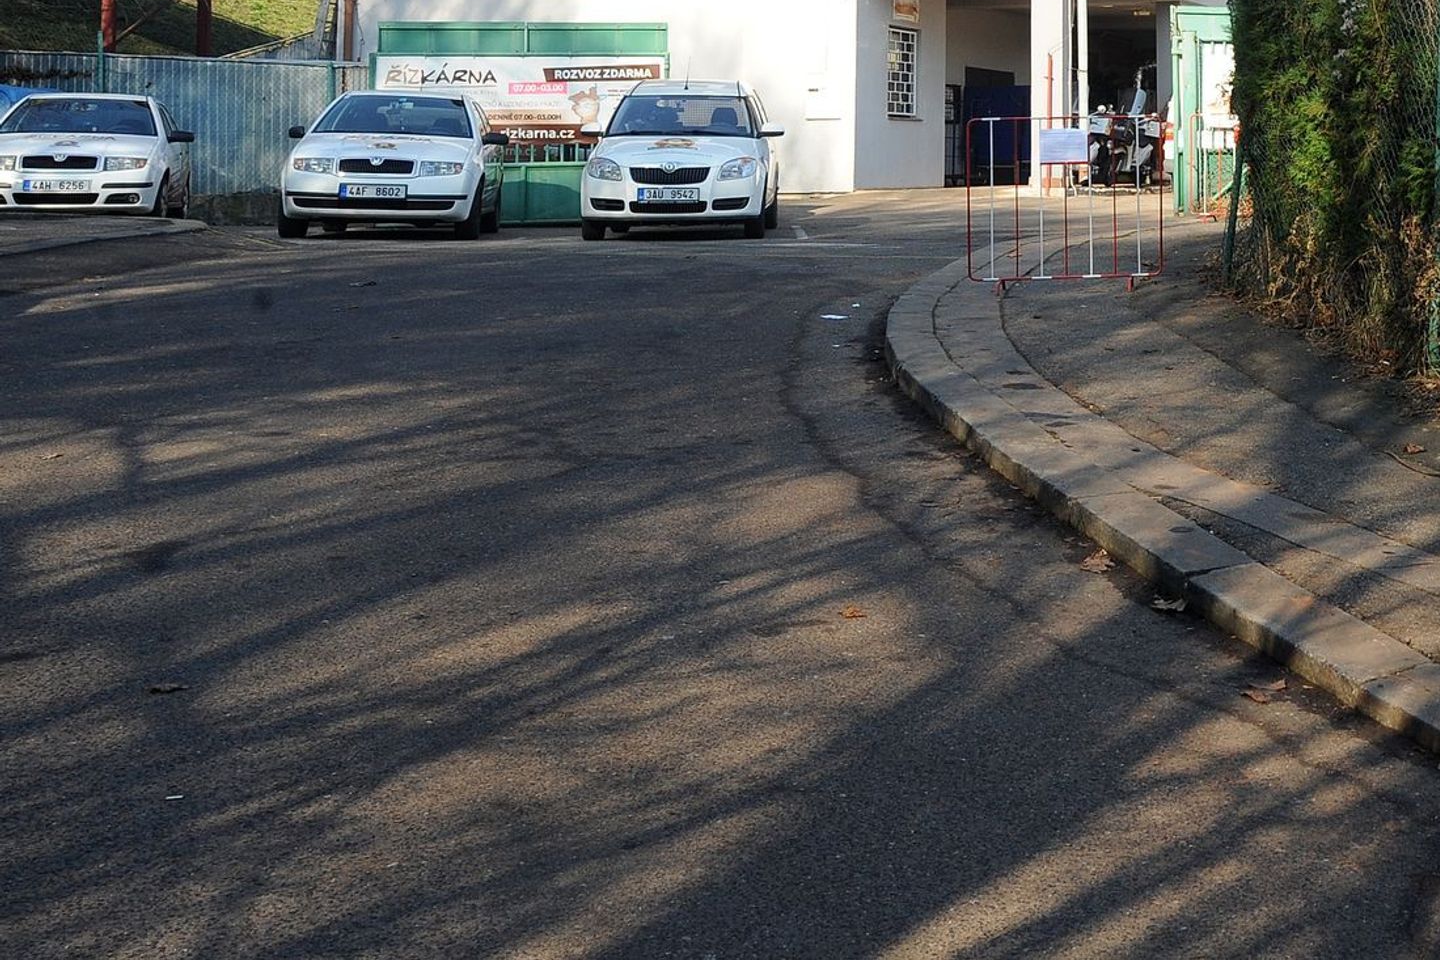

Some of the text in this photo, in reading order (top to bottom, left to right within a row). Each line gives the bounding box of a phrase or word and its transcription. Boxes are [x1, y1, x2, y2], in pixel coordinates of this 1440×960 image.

[385, 62, 498, 85] ŘÍZKÁRNA
[554, 67, 653, 80] ROZVOZ ZDARMA
[512, 83, 564, 93] 07.00-03.00
[31, 179, 85, 191] 4AH 6256
[348, 186, 401, 197] 4AF 8602
[646, 190, 695, 200] 3AU 9542
